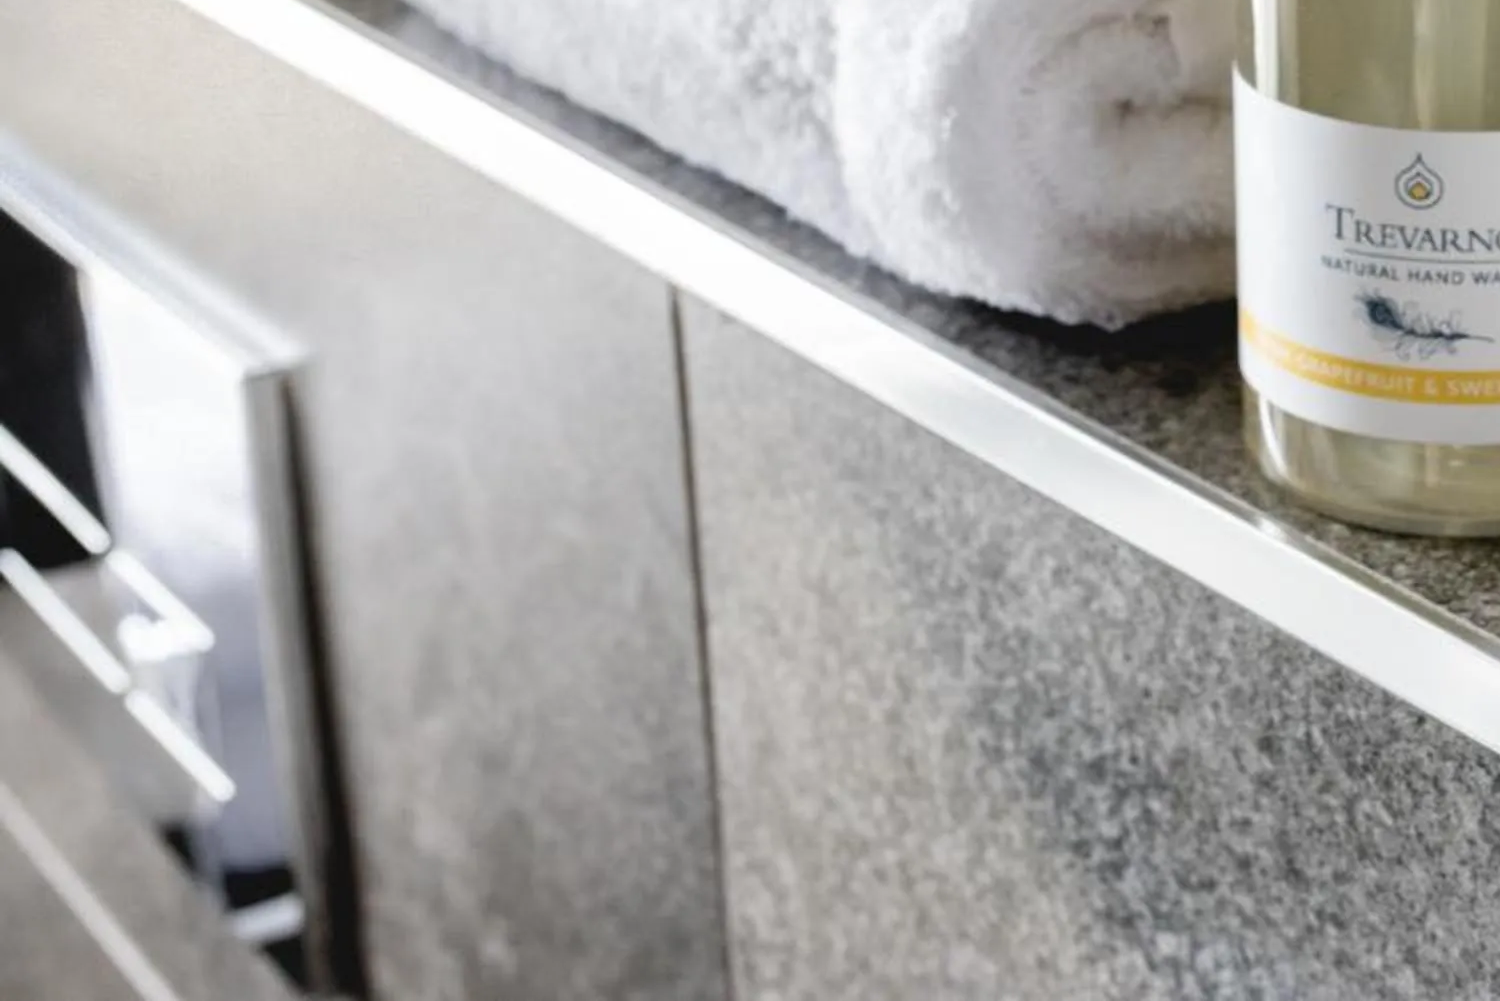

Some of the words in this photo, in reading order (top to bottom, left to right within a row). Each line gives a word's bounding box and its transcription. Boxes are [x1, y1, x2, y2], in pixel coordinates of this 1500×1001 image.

[1321, 255, 1400, 282] NATURAL
[1407, 268, 1466, 286] HAND
[1424, 374, 1439, 395] &
